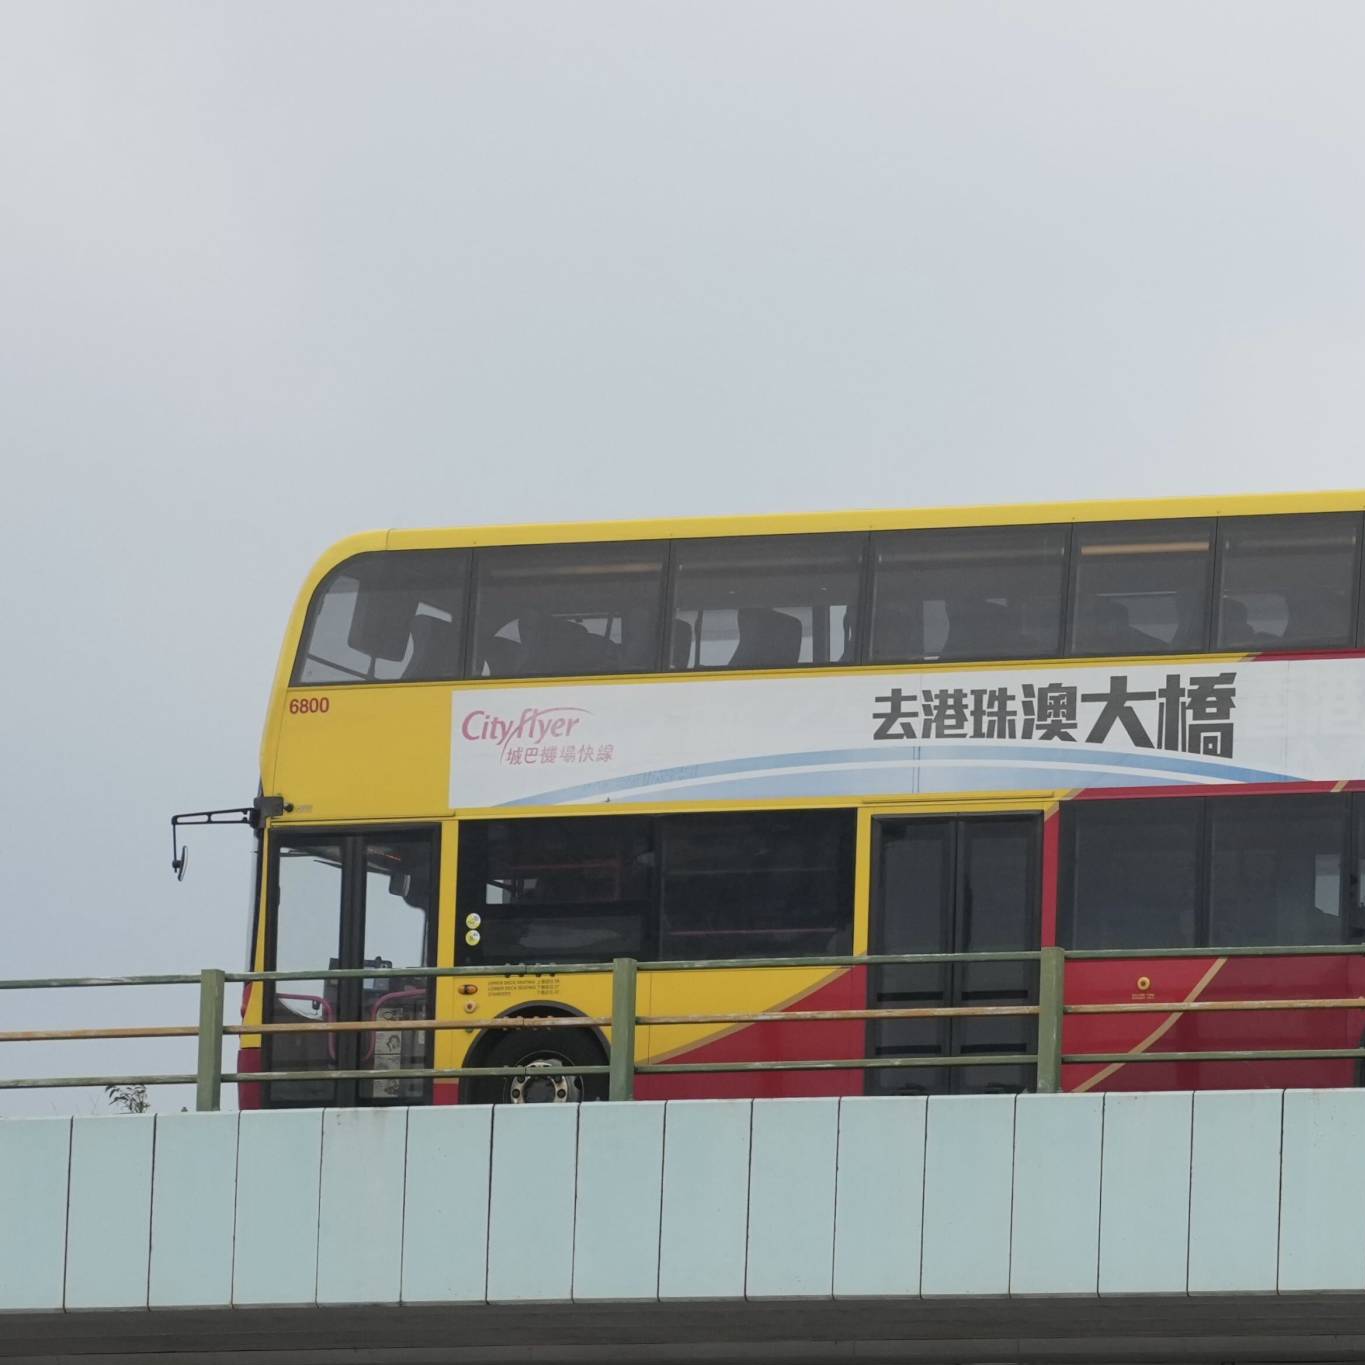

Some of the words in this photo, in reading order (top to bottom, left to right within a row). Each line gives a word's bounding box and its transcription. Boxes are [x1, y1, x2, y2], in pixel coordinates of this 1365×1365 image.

[289, 697, 330, 715] 6800
[871, 671, 1238, 760] 去港珠澳大橋
